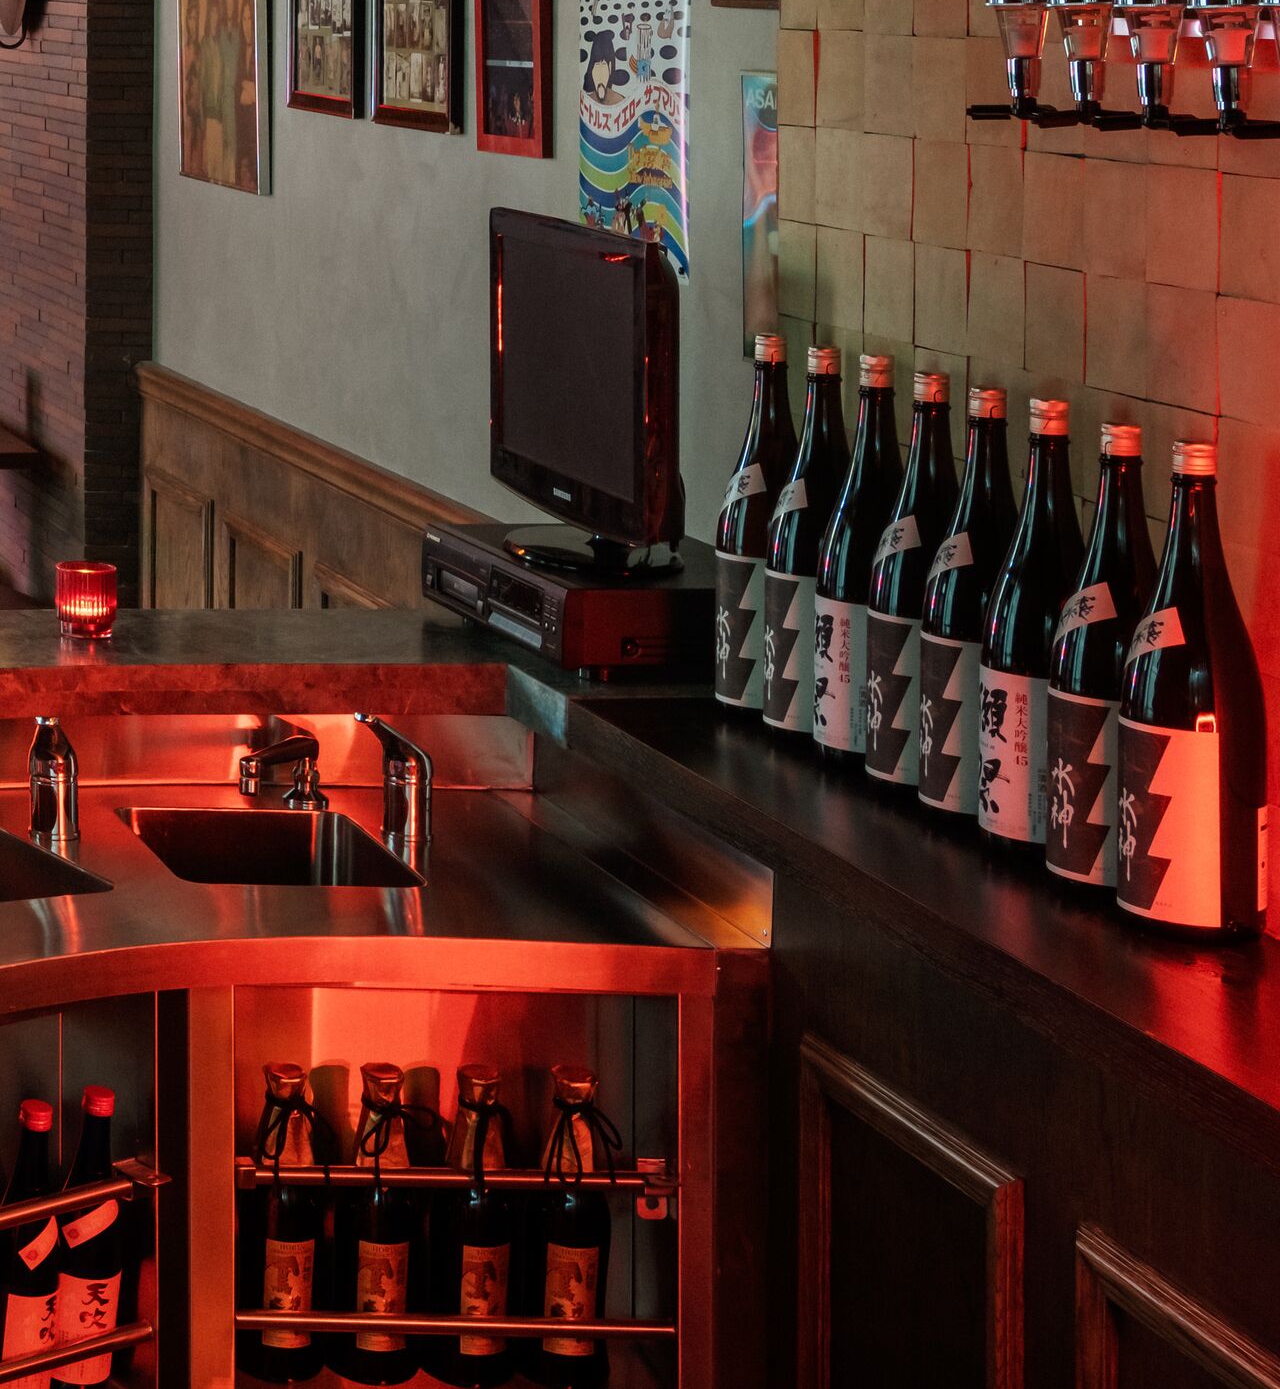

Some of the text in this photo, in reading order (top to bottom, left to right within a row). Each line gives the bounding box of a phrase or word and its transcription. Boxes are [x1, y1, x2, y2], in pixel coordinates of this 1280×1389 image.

[579, 97, 611, 132] ビートルズ
[613, 97, 642, 132] イエロー
[745, 88, 777, 110] ASA
[716, 605, 731, 679] 水神
[867, 670, 883, 751] 水神
[919, 694, 933, 777] 水神
[1050, 757, 1075, 849] 水神
[1118, 787, 1137, 882] 水神
[79, 1282, 110, 1330] 天吹
